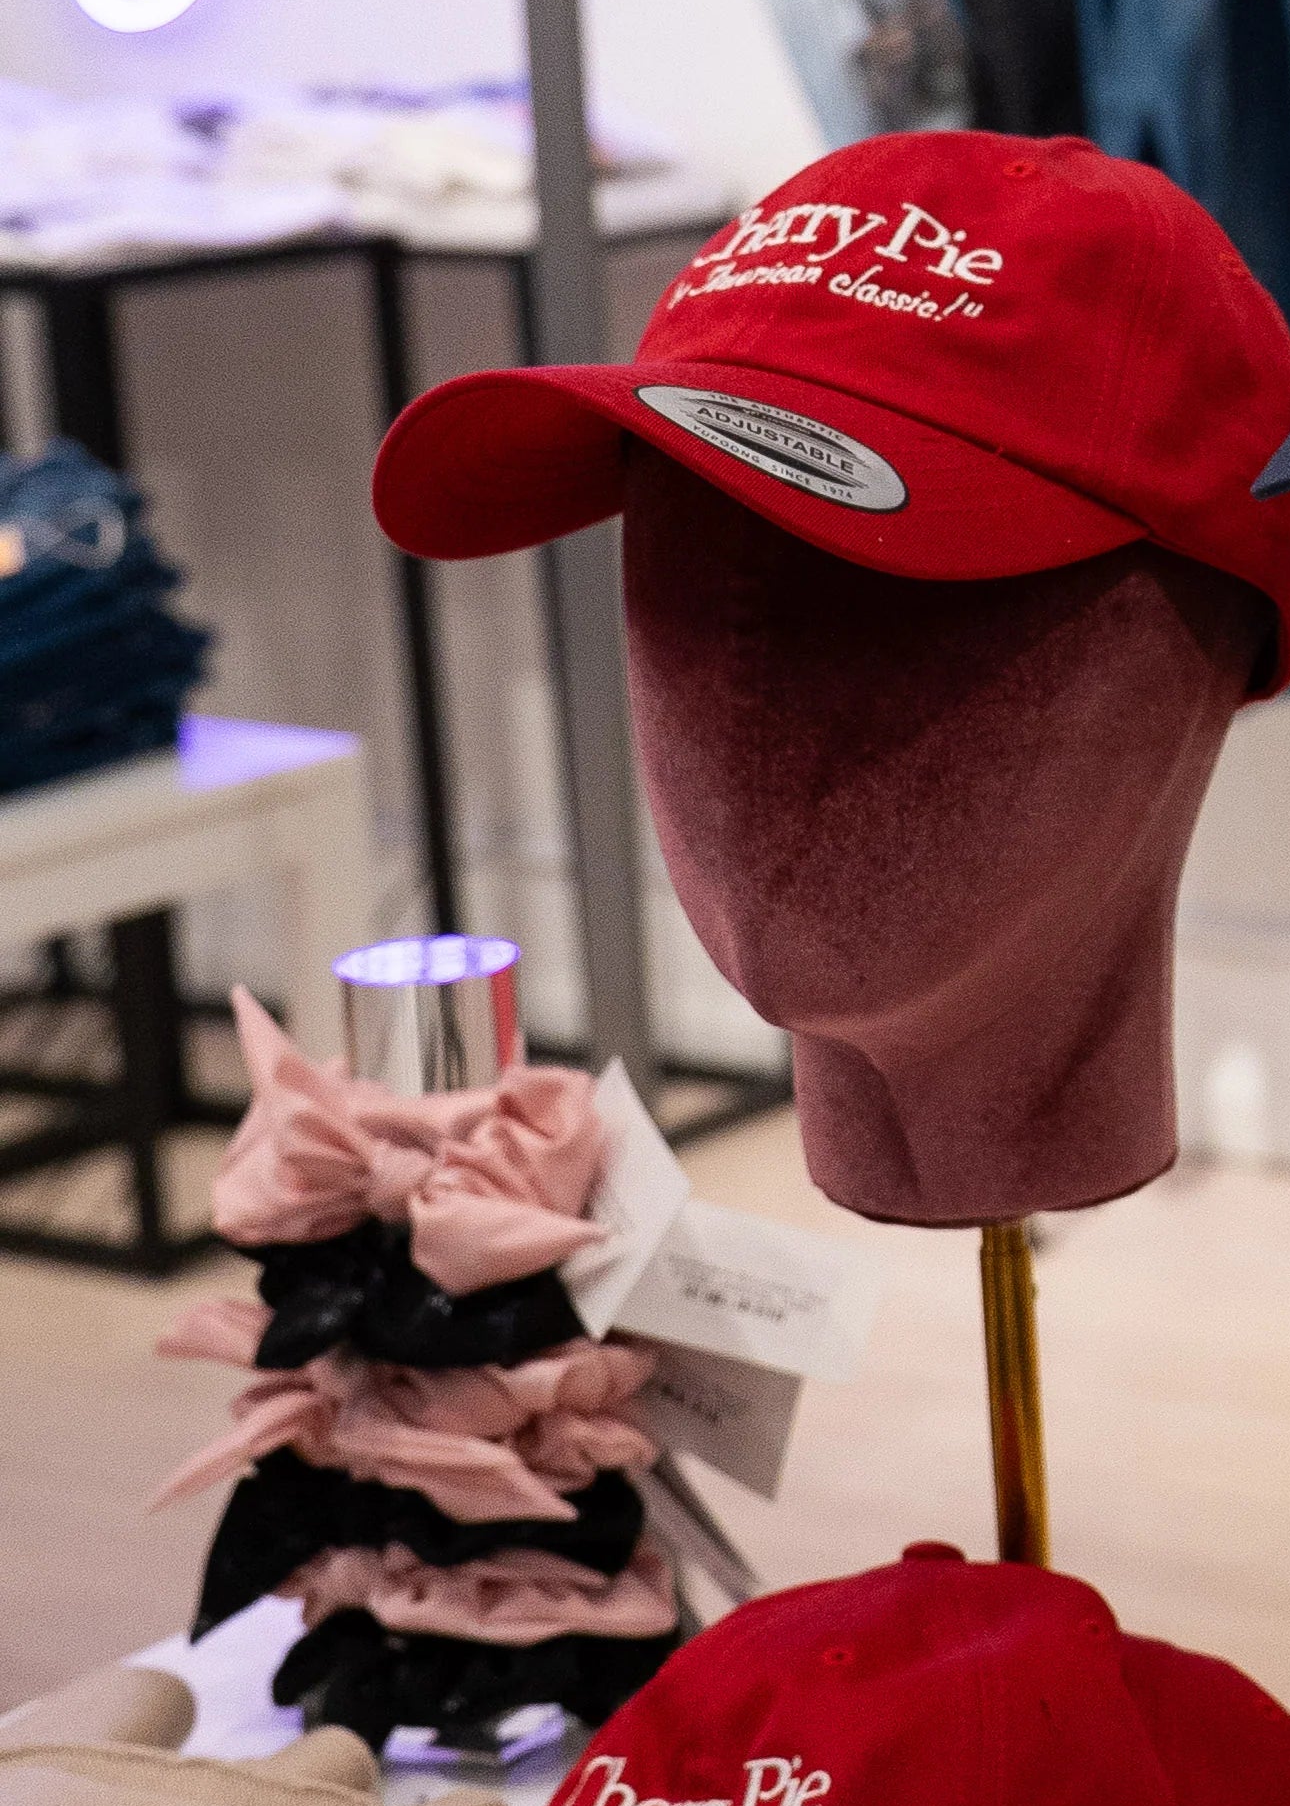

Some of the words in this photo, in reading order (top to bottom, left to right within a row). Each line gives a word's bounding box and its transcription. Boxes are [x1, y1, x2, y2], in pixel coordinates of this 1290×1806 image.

[874, 202, 1003, 285] Pie
[697, 406, 855, 476] ADJUSTABLE
[771, 464, 812, 487] SINCE
